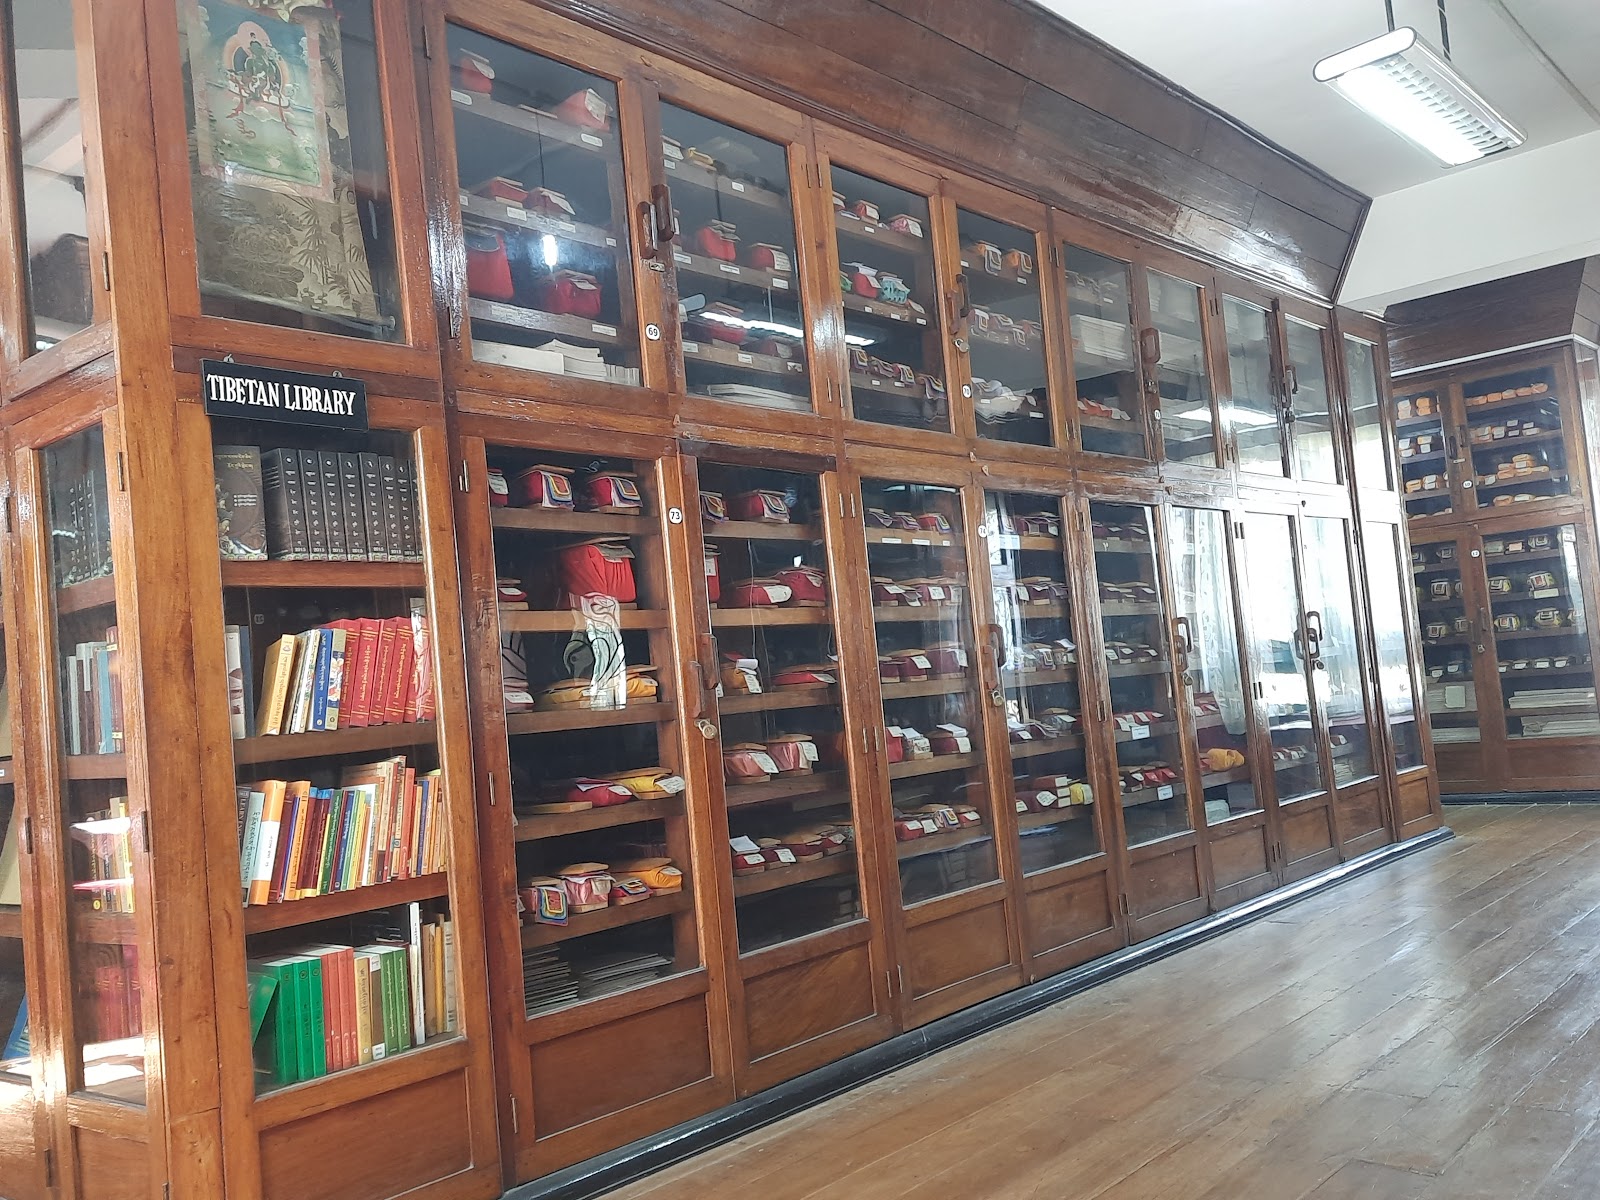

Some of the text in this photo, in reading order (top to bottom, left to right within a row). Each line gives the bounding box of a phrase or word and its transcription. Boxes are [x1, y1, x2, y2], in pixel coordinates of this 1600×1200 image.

[648, 327, 658, 337] 69
[206, 373, 357, 416] TIBETAN LIBRARY
[670, 511, 680, 520] 73
[239, 798, 247, 819] LEARN
